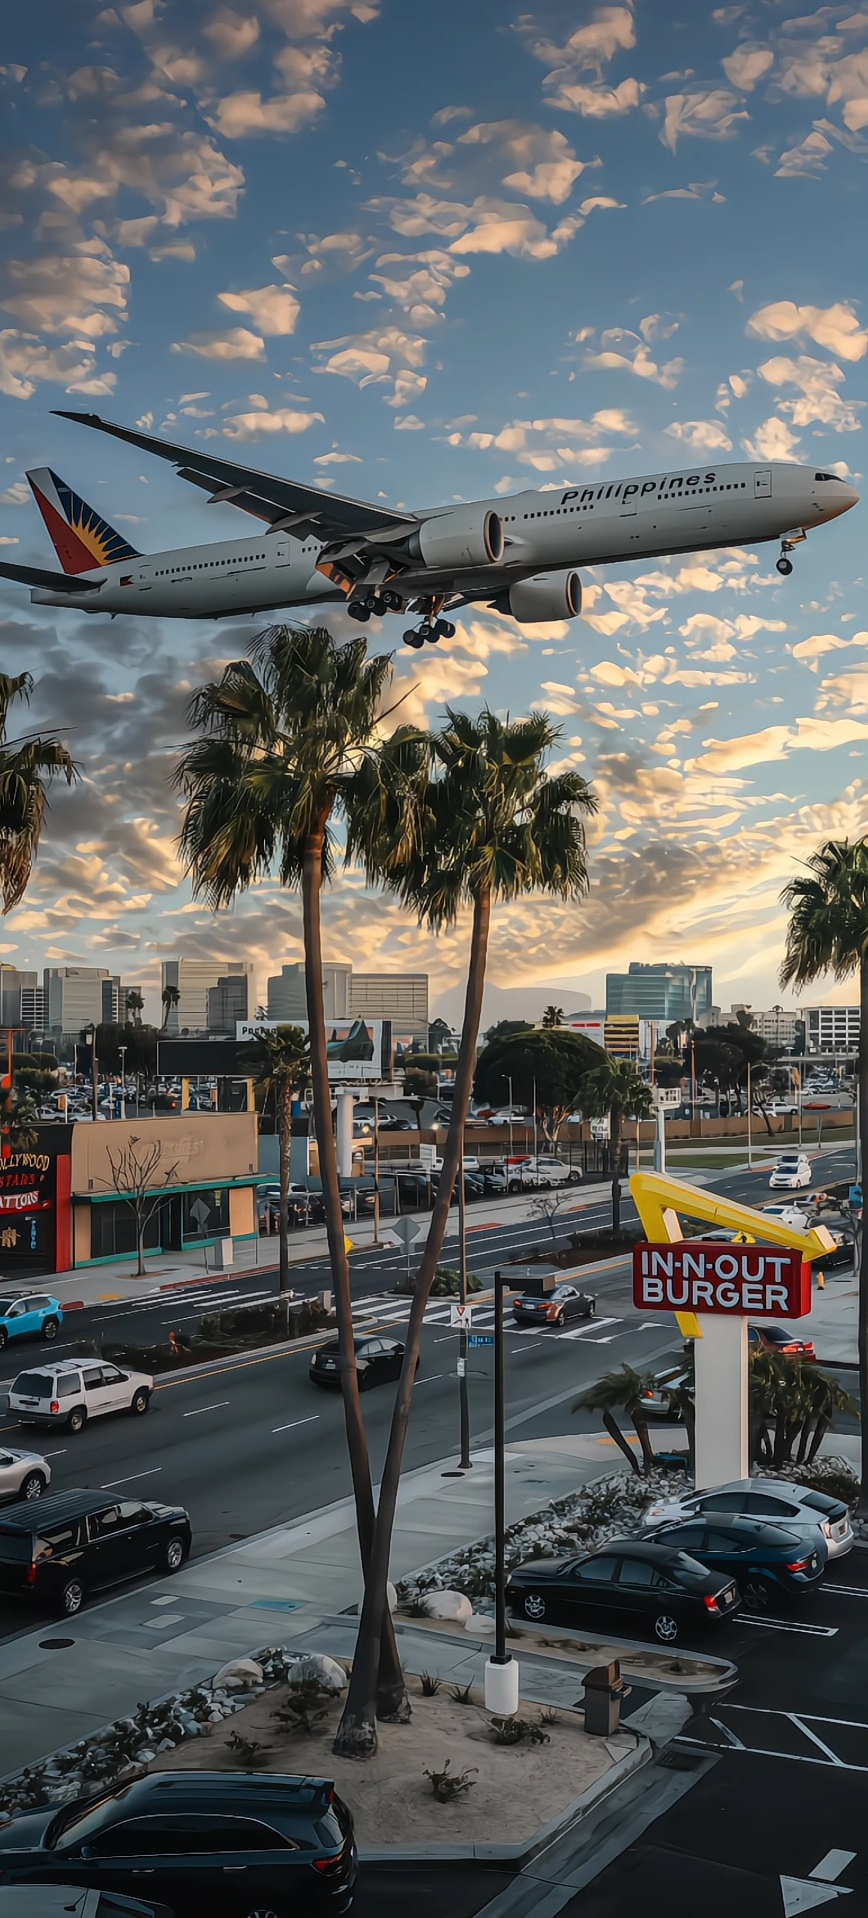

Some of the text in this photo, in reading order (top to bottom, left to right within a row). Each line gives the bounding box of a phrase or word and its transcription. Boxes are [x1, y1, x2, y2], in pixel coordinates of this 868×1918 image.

[560, 472, 717, 505] Philippines
[0, 1153, 50, 1171] LLYWOOD
[641, 1251, 791, 1283] IN-N-OUT
[642, 1277, 789, 1311] BURGER
